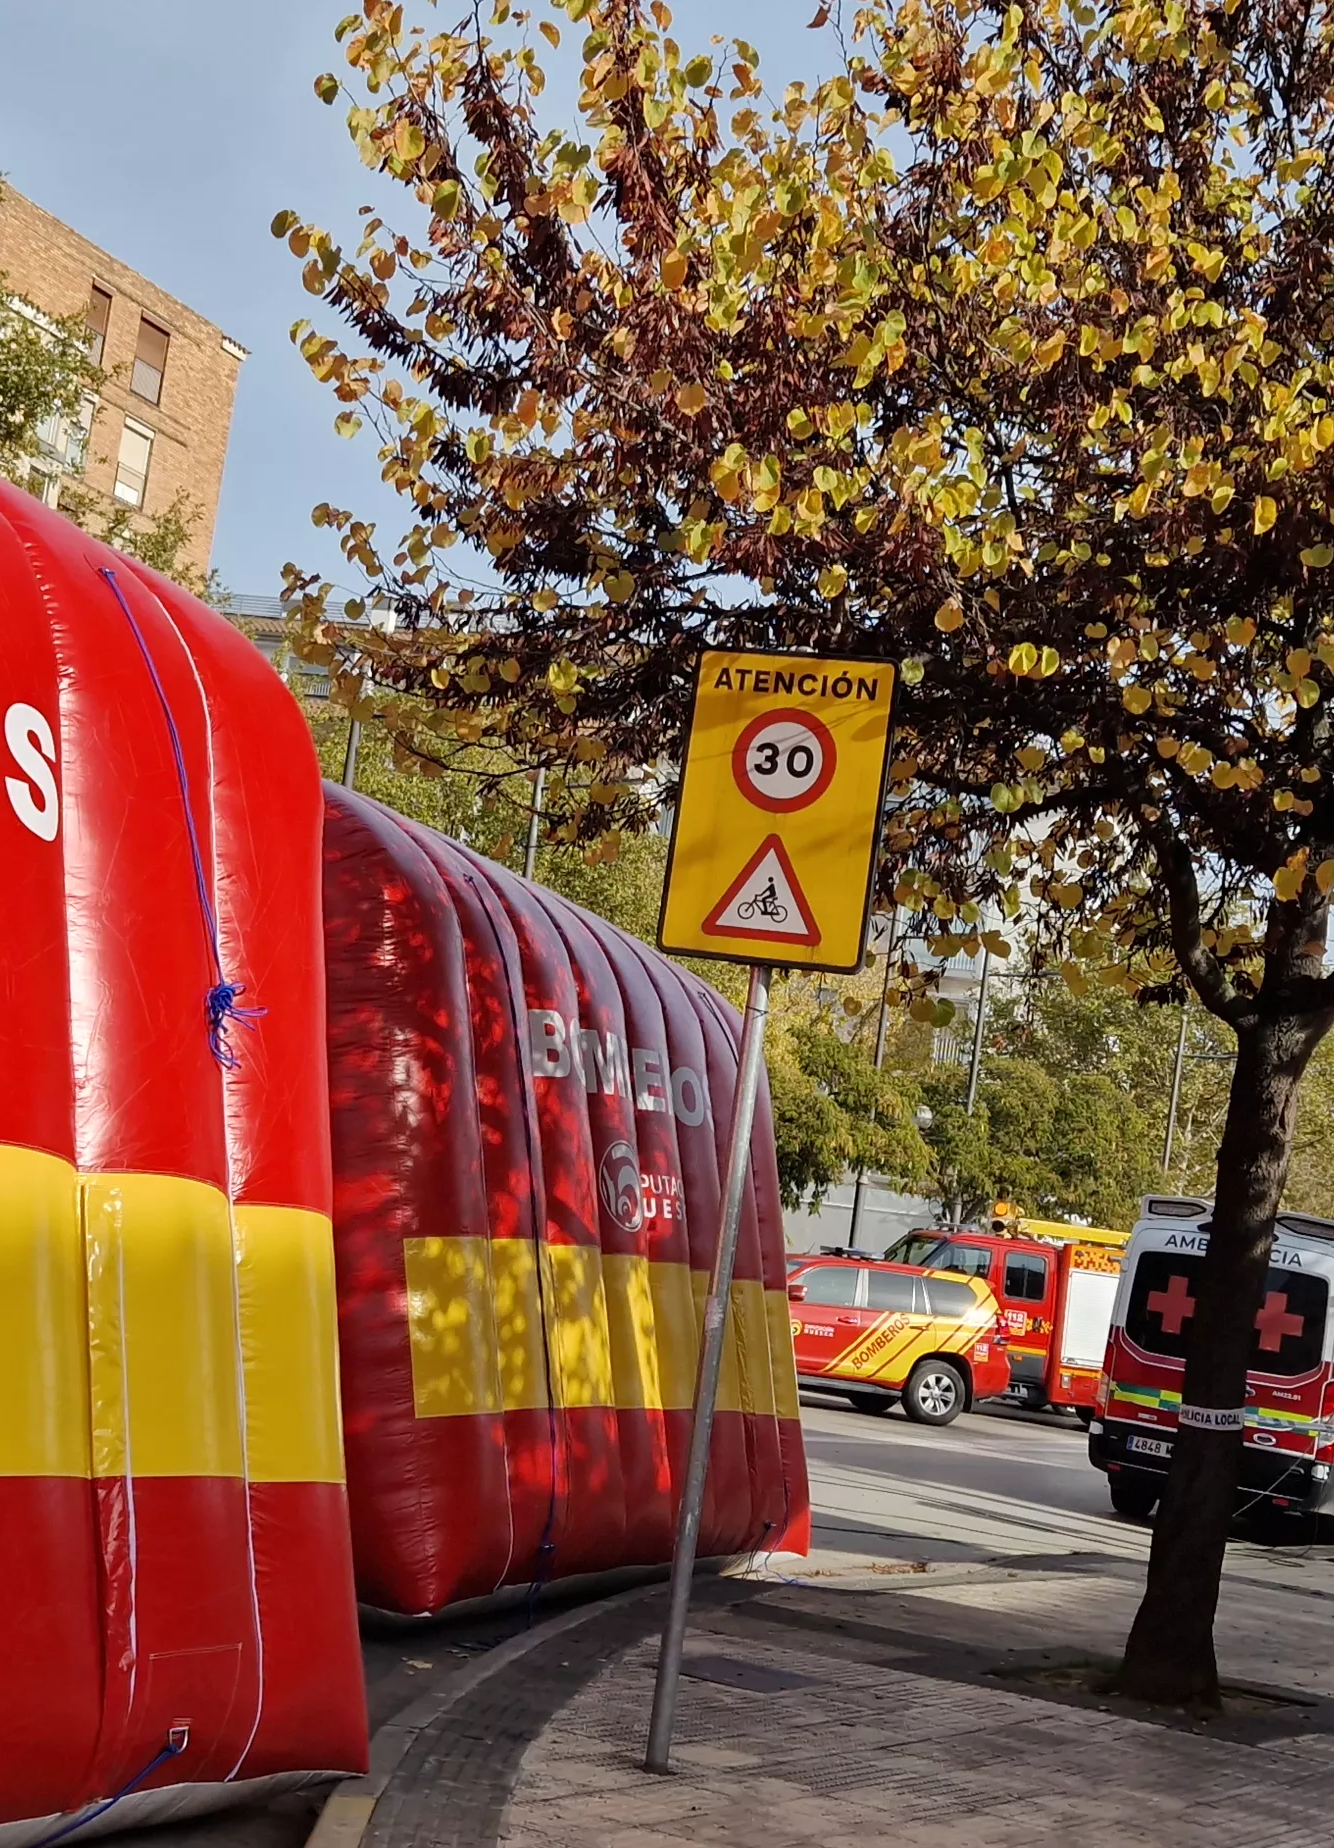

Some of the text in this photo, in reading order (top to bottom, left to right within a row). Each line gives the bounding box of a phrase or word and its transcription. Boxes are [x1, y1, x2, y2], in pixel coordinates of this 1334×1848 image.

[714, 667, 879, 701] ATENCIÓN
[754, 742, 814, 779] 30
[1165, 1234, 1302, 1267] AMBCIA
[851, 1313, 910, 1370] BOMBEROS
[1215, 1414, 1241, 1425] LOCAL
[1134, 1440, 1161, 1453] 4848
